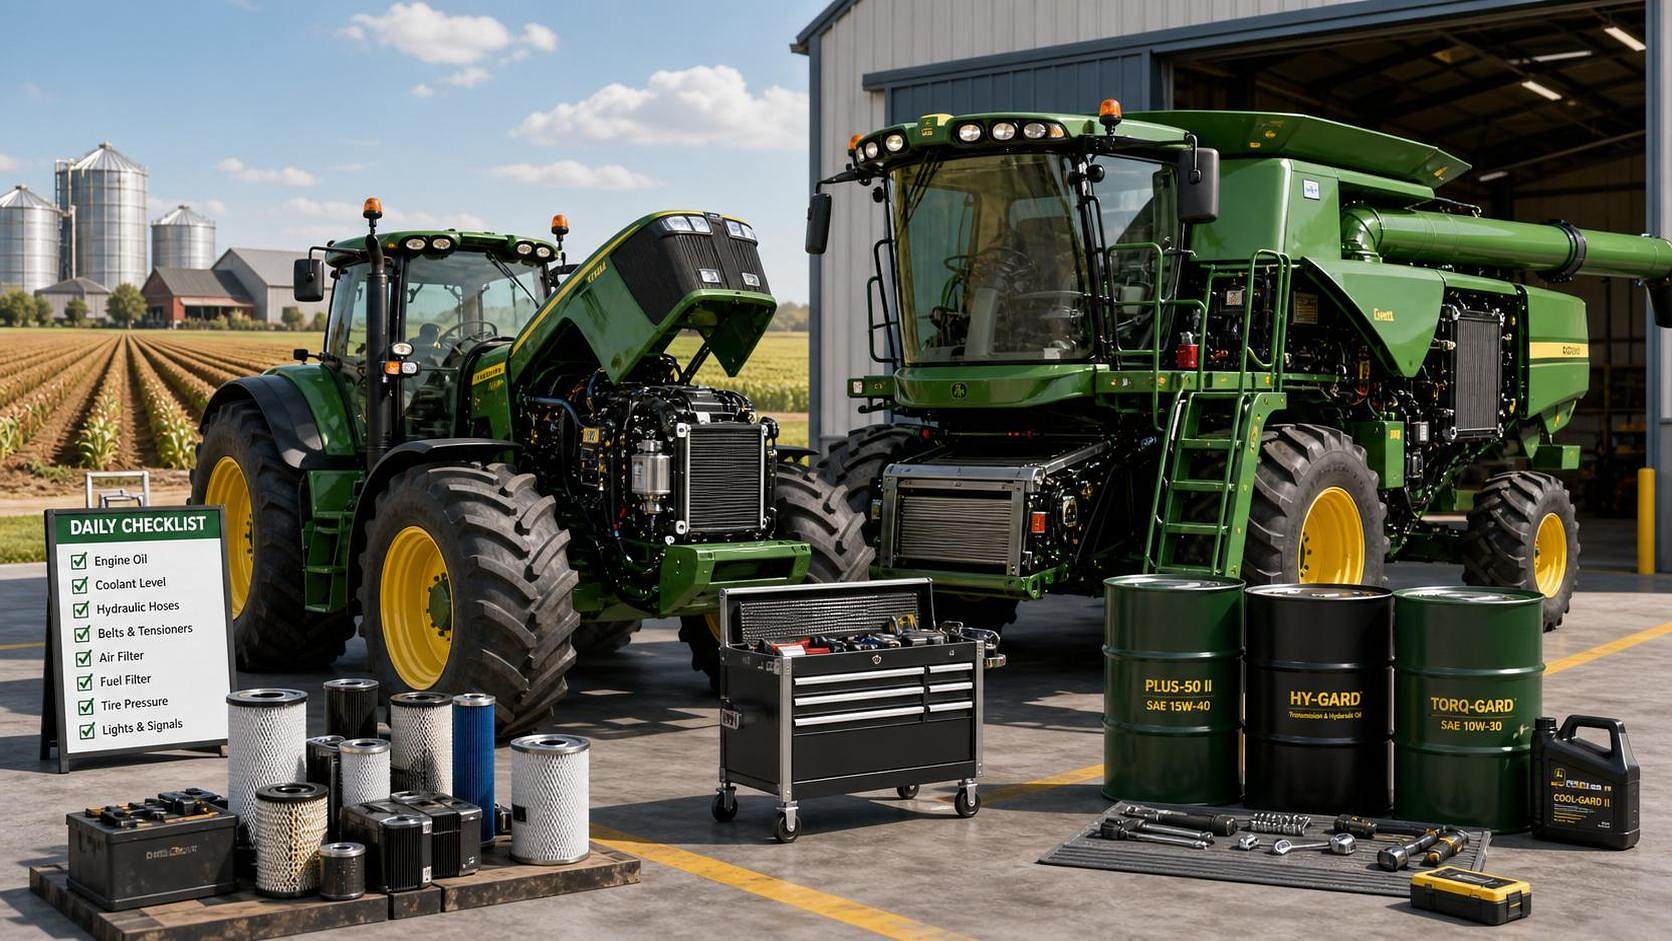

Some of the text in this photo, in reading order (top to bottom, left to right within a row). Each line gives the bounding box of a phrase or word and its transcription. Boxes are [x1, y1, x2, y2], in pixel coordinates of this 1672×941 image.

[70, 516, 206, 535] DAILY CHECKLIST
[94, 554, 147, 568] Engine Oil
[95, 577, 166, 590] Coolant Level
[96, 601, 180, 616] Hydraulic Hoses
[98, 625, 193, 639] Belts & Tensioners
[99, 651, 144, 663] Air Filter
[100, 674, 151, 687] Fuel Filter
[1145, 679, 1212, 693] PLUS-50 II
[101, 698, 168, 711] Tire Pressure
[1290, 690, 1361, 706] HY-GARD
[1146, 700, 1211, 712] SAE 15W-40
[1430, 697, 1514, 714] TORQ-GARD
[102, 718, 183, 737] Lights & Signals
[1441, 720, 1502, 732] SAE 10W-30
[1553, 793, 1602, 806] COOL-GARD
[1604, 798, 1610, 808] II
